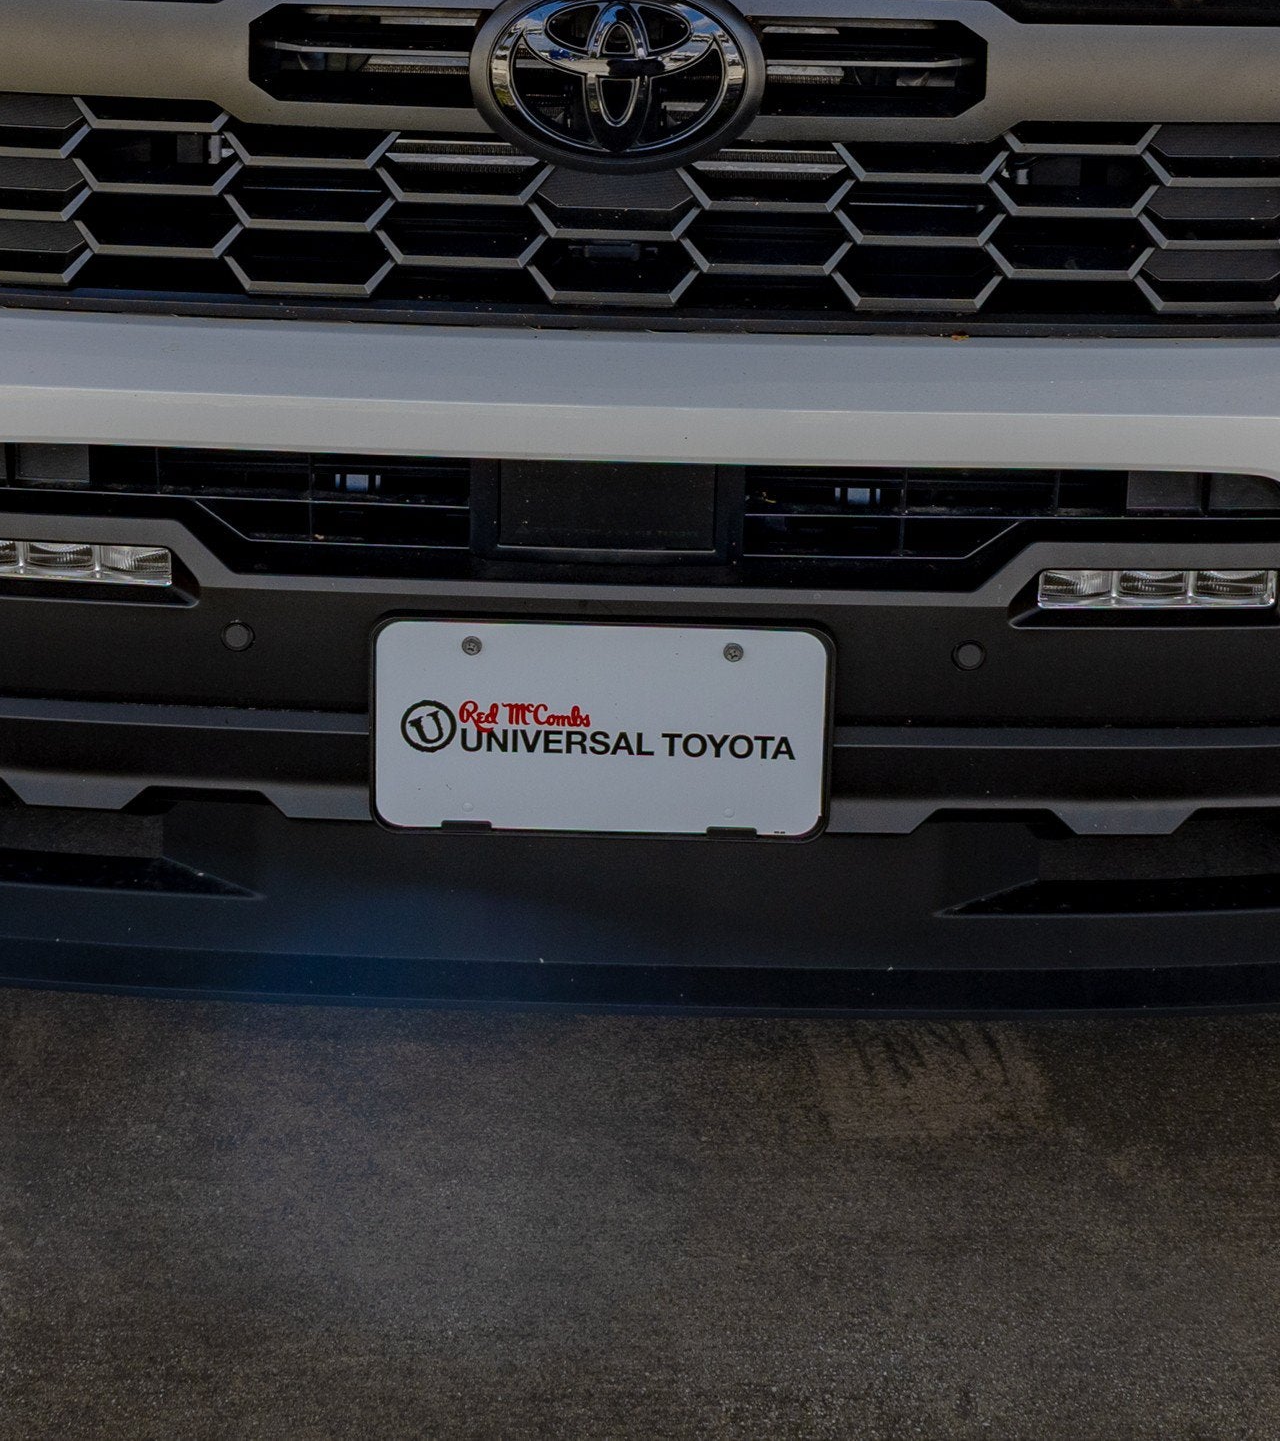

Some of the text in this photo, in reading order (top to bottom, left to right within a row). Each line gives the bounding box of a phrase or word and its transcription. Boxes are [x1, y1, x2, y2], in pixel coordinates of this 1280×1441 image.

[458, 700, 591, 733] Red McCombs
[460, 728, 796, 760] UNIVERSAL TOYOTA
